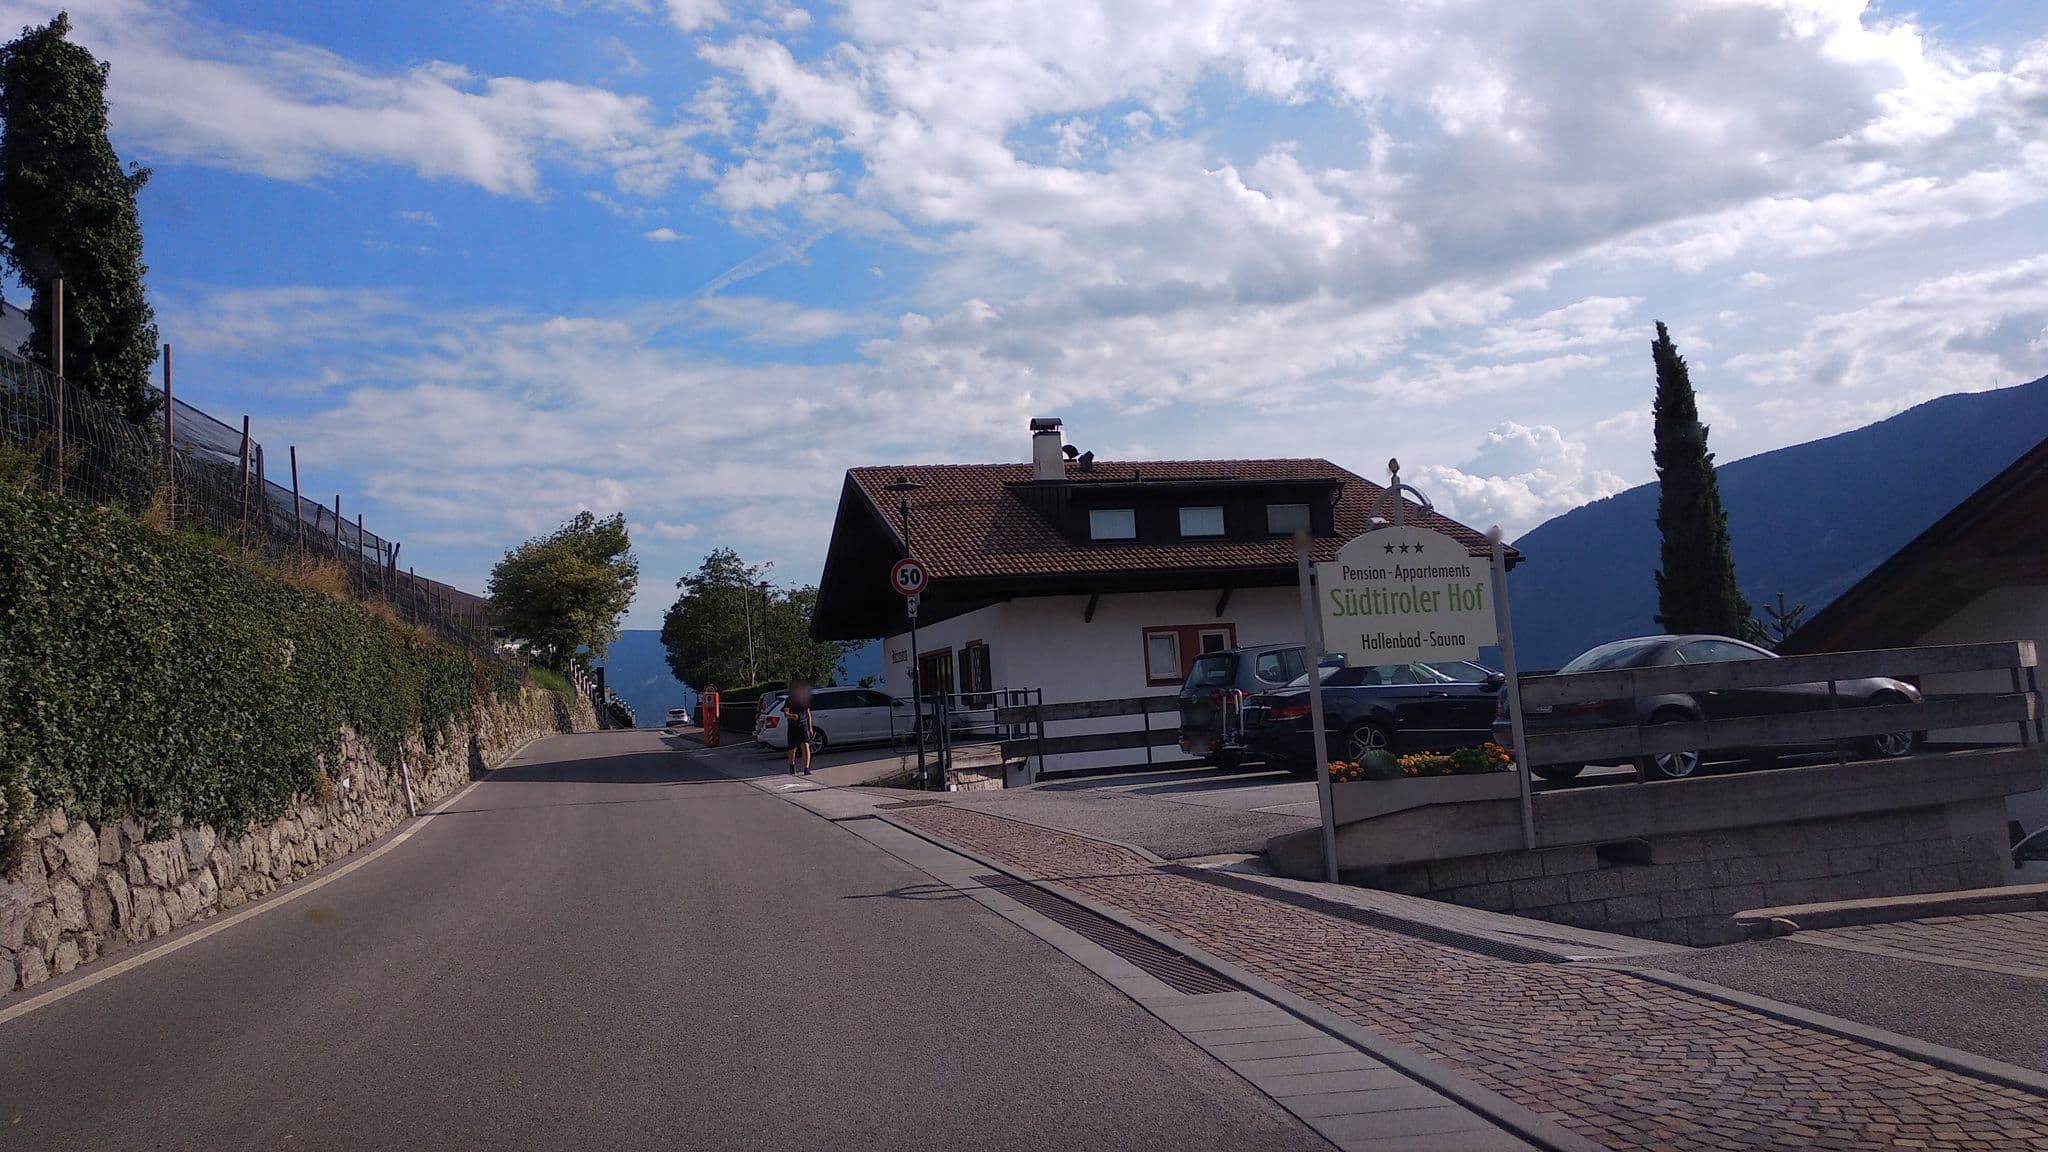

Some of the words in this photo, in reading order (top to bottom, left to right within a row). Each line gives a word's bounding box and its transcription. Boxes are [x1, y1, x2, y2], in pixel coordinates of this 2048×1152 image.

[899, 568, 921, 586] 50
[1330, 585, 1441, 617] Südtiroler
[1447, 582, 1484, 612] Hof
